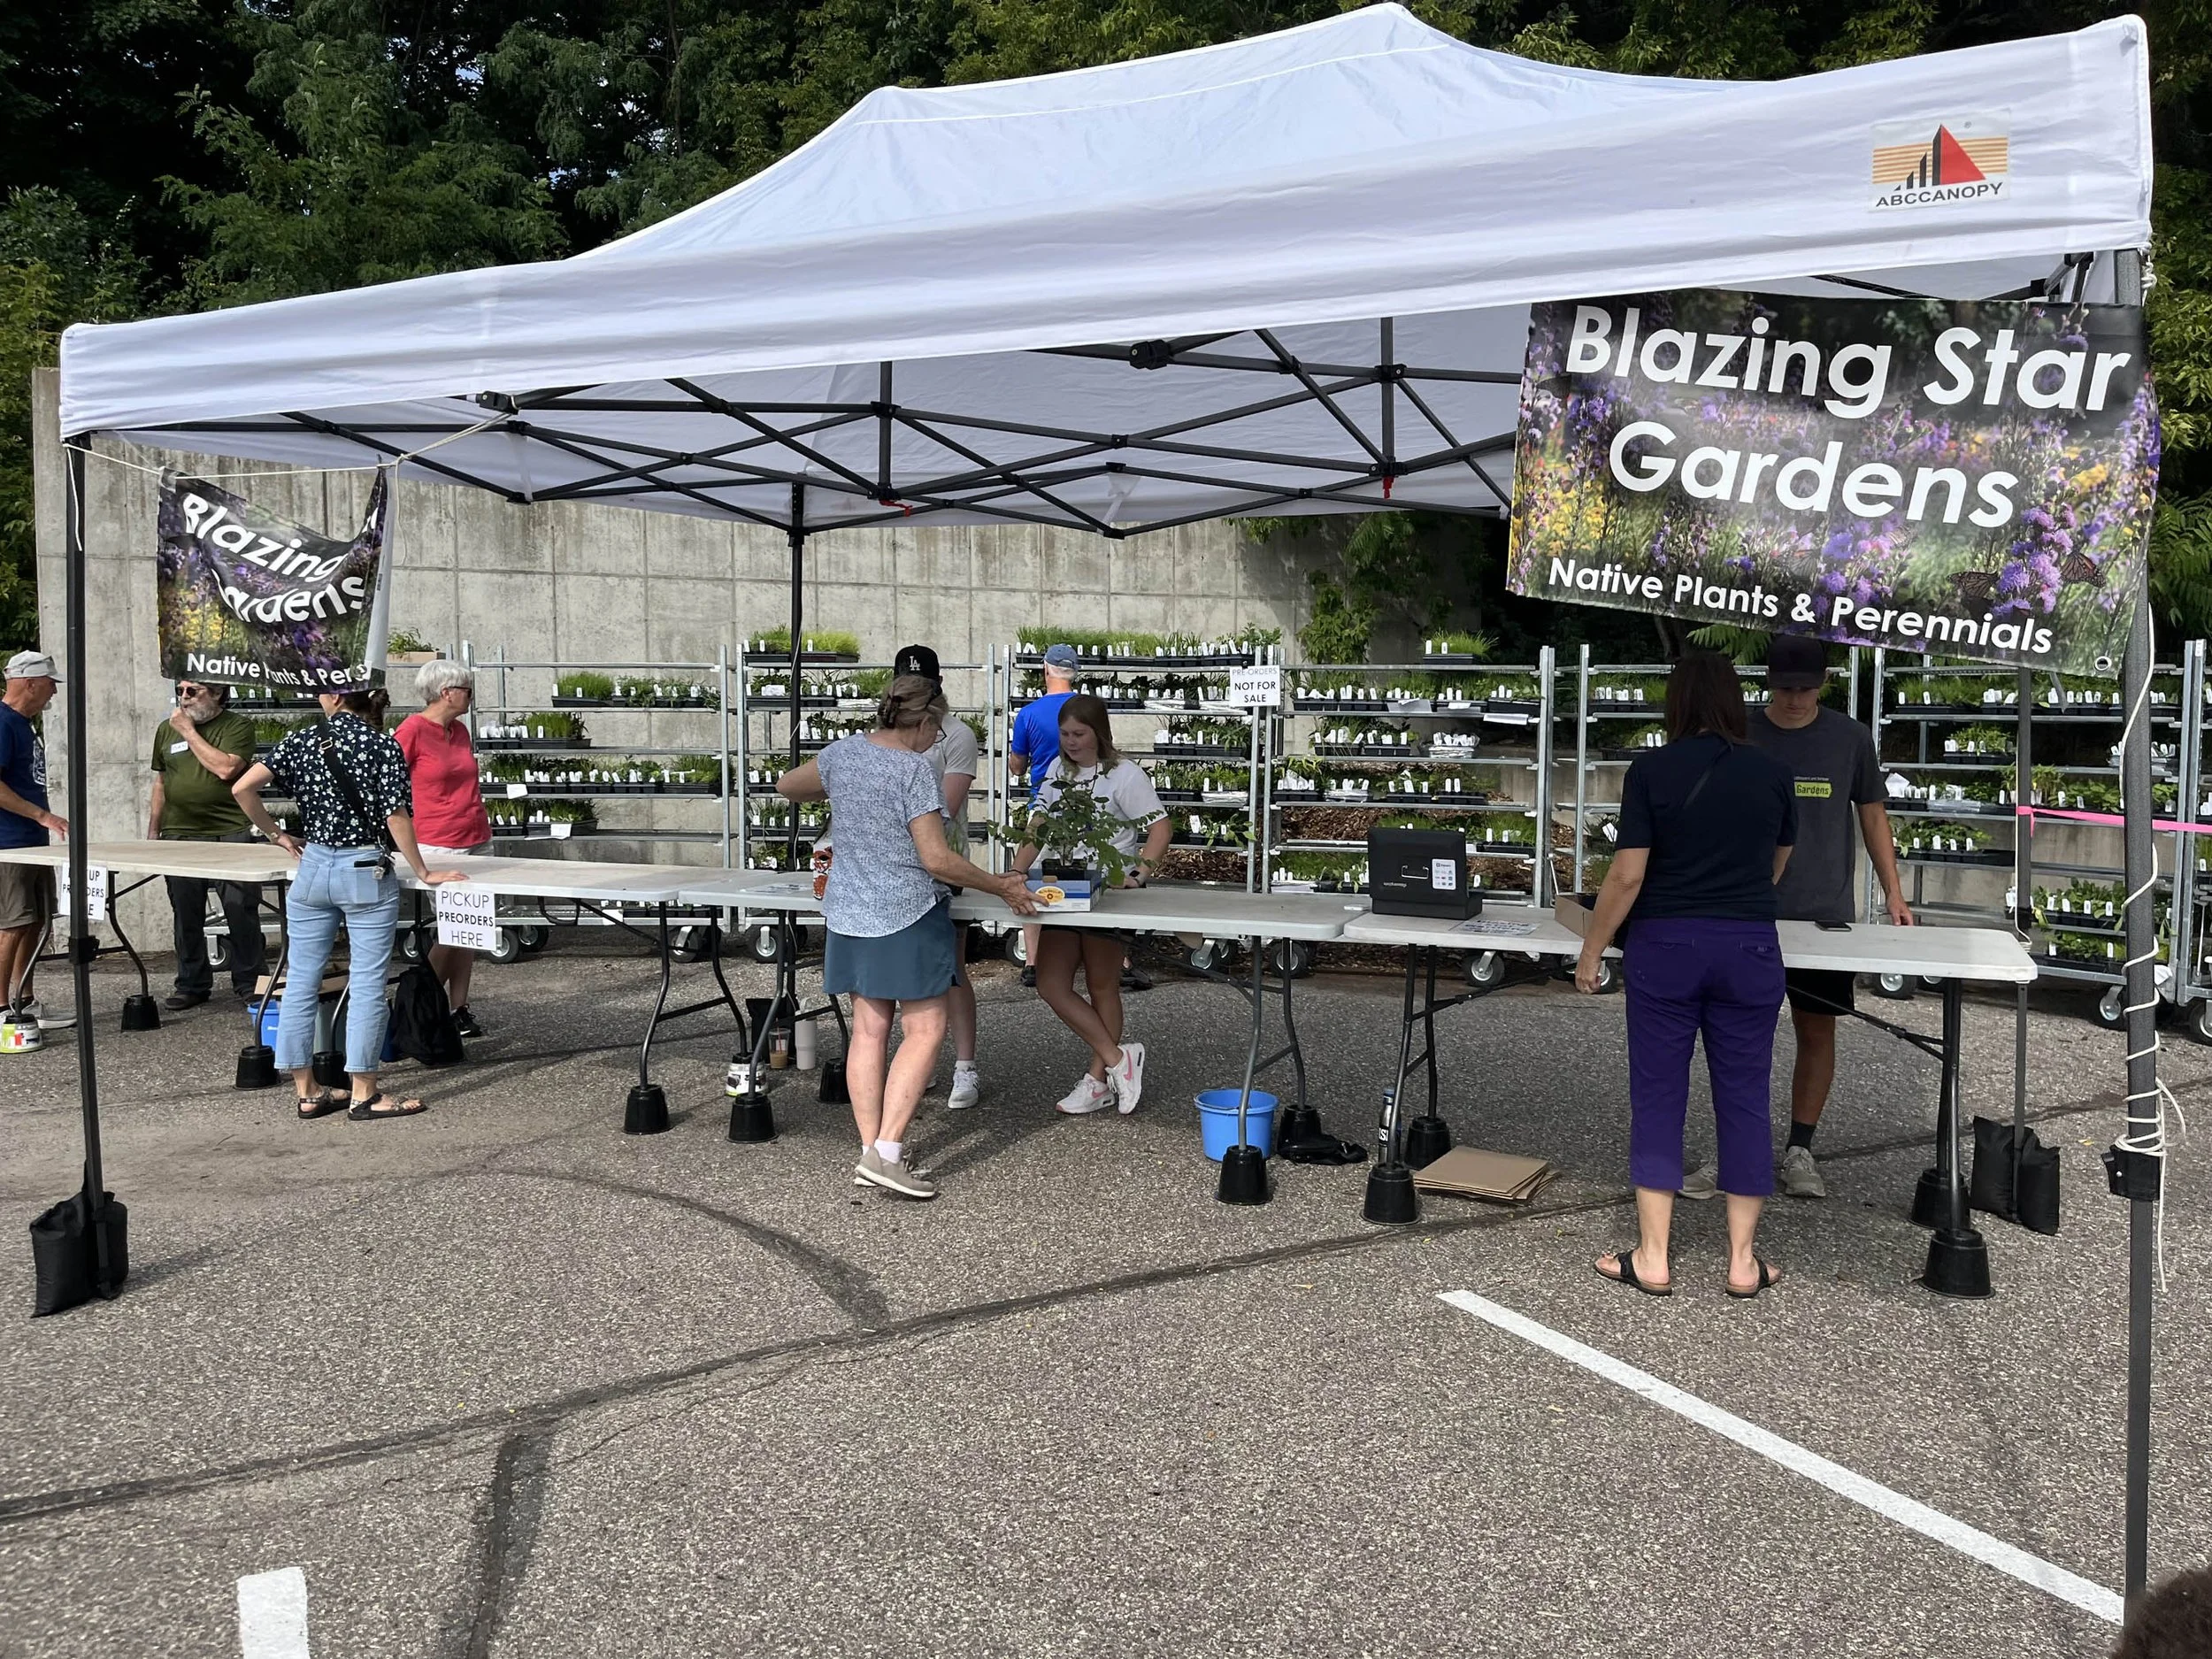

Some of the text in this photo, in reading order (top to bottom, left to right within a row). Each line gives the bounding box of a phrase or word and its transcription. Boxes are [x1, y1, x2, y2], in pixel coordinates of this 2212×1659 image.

[1876, 182, 2003, 207] ABCCANOPY
[1566, 305, 2131, 419] Blazing Star
[1609, 421, 2019, 528] Gardens
[182, 492, 349, 583] Blazing
[1548, 557, 2054, 655] Native Plants & Perennials
[187, 653, 261, 678] Native
[301, 669, 318, 687] &
[909, 656, 920, 671] LA
[1234, 681, 1254, 690] NOT
[1244, 694, 1266, 703] SALE
[1796, 784, 1830, 795] Gardens
[63, 884, 104, 898] PRDERS
[441, 890, 489, 909] PICKUP
[439, 911, 494, 927] PREORDERS
[450, 930, 483, 947] HERE
